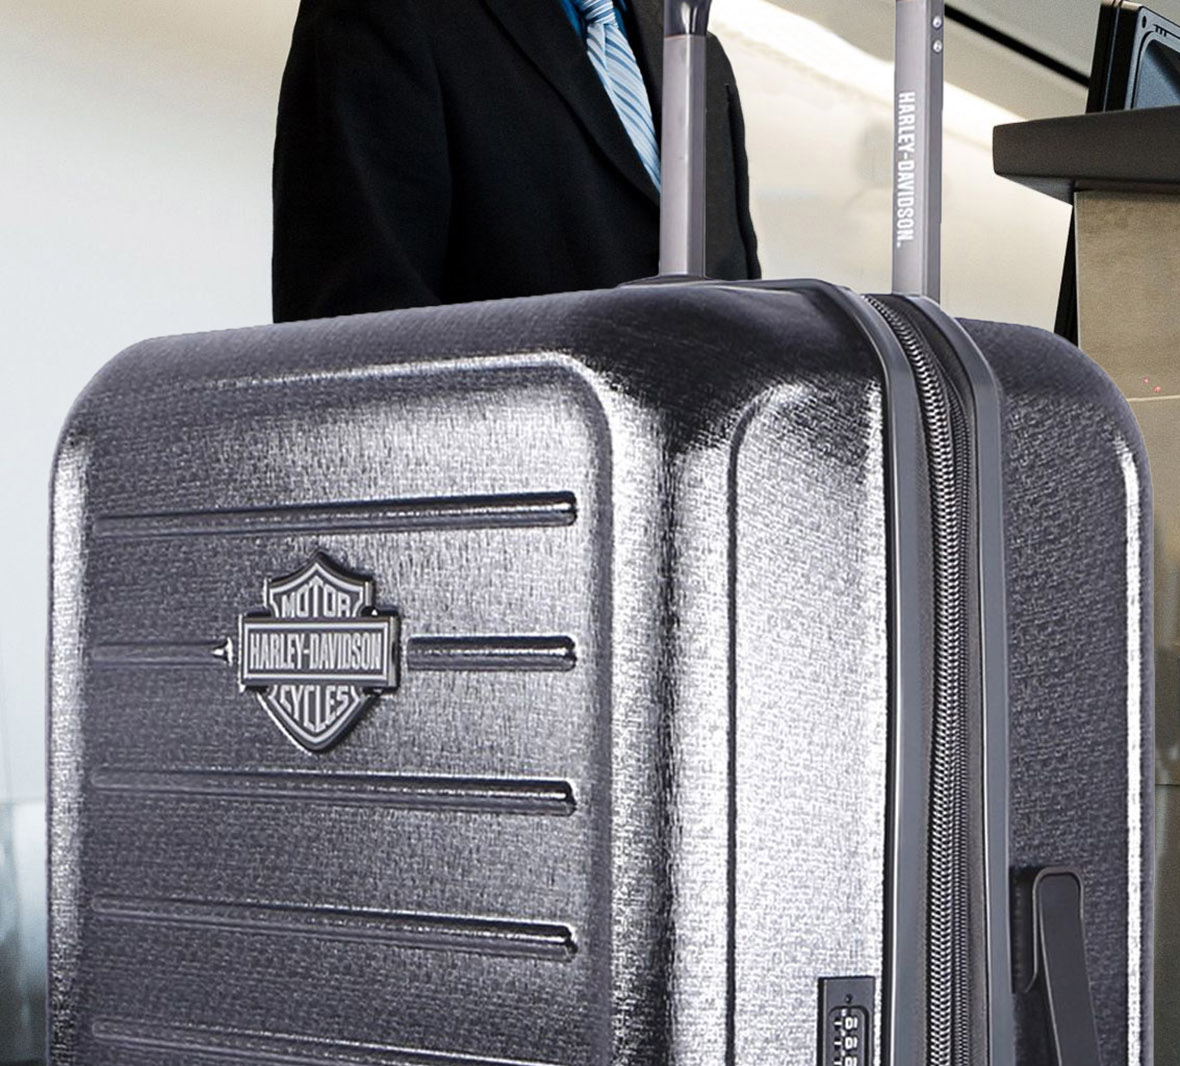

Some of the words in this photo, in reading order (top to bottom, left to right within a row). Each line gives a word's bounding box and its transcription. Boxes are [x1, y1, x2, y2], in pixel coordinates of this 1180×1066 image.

[281, 575, 351, 618] MOTOR
[249, 632, 383, 670] HARLEY-DAVIDSON
[280, 684, 350, 733] CYCLES
